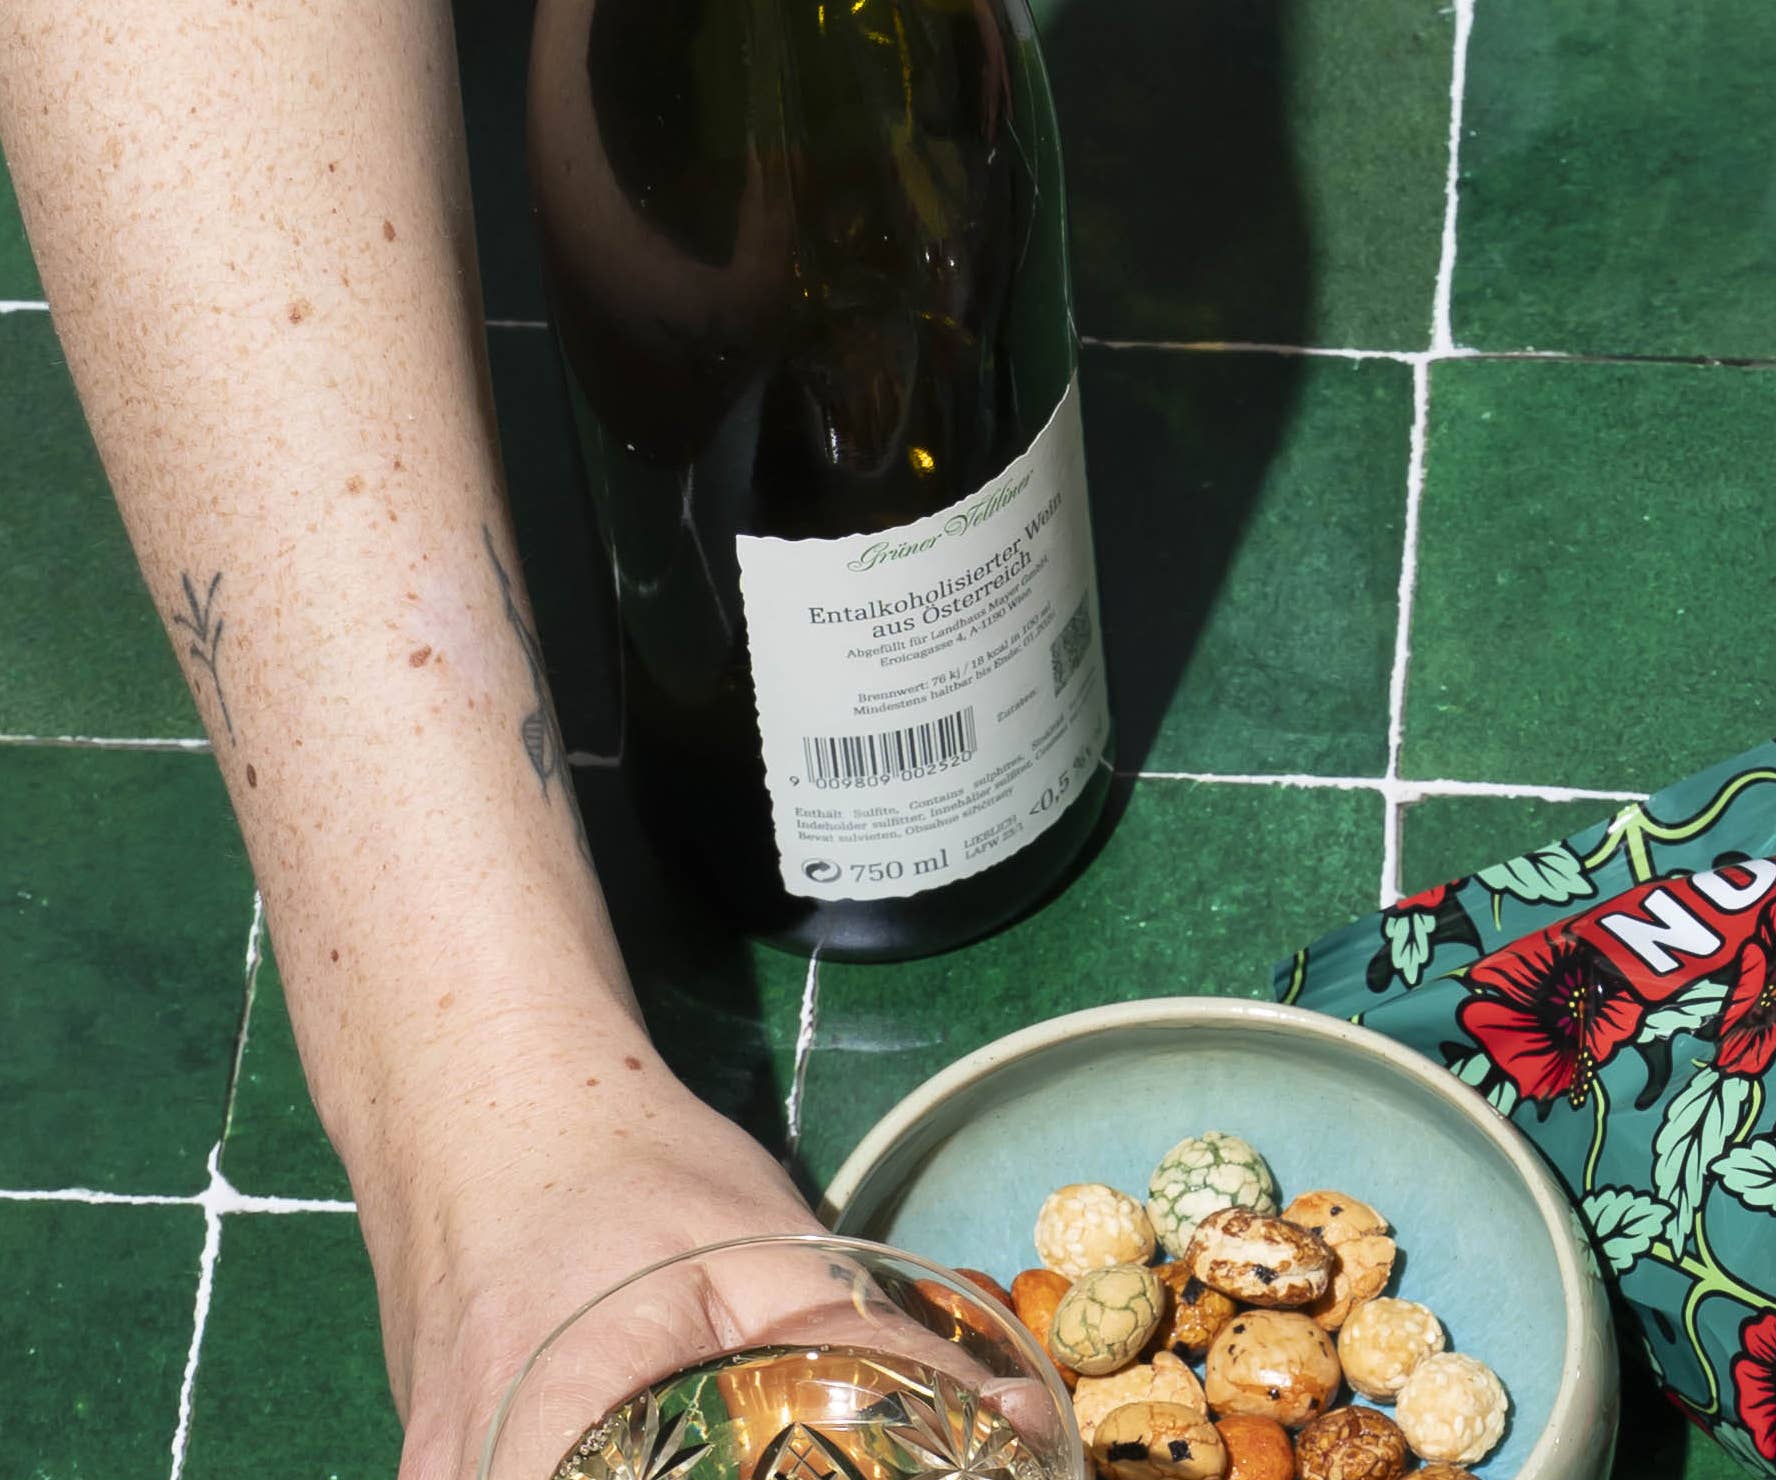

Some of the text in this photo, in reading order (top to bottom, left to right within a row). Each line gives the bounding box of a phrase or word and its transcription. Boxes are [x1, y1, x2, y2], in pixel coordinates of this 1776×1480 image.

[808, 492, 1061, 624] Entalkoholisierter Wein
[847, 533, 943, 572] Grüner
[872, 551, 1031, 638] aus Österreich
[846, 641, 906, 659] Abgefüllt
[909, 635, 928, 647] für
[931, 608, 986, 640] Landhaus
[988, 584, 1019, 611] Mayer
[880, 639, 953, 667] Eroicagasse
[970, 608, 1006, 637] A-1190
[853, 695, 927, 716] Mindestens
[930, 676, 973, 700] haltbar
[858, 681, 929, 703] Brennwert:
[789, 750, 972, 790] 9 009809 002520
[909, 788, 964, 810] Contains
[850, 848, 949, 883] 750 ml
